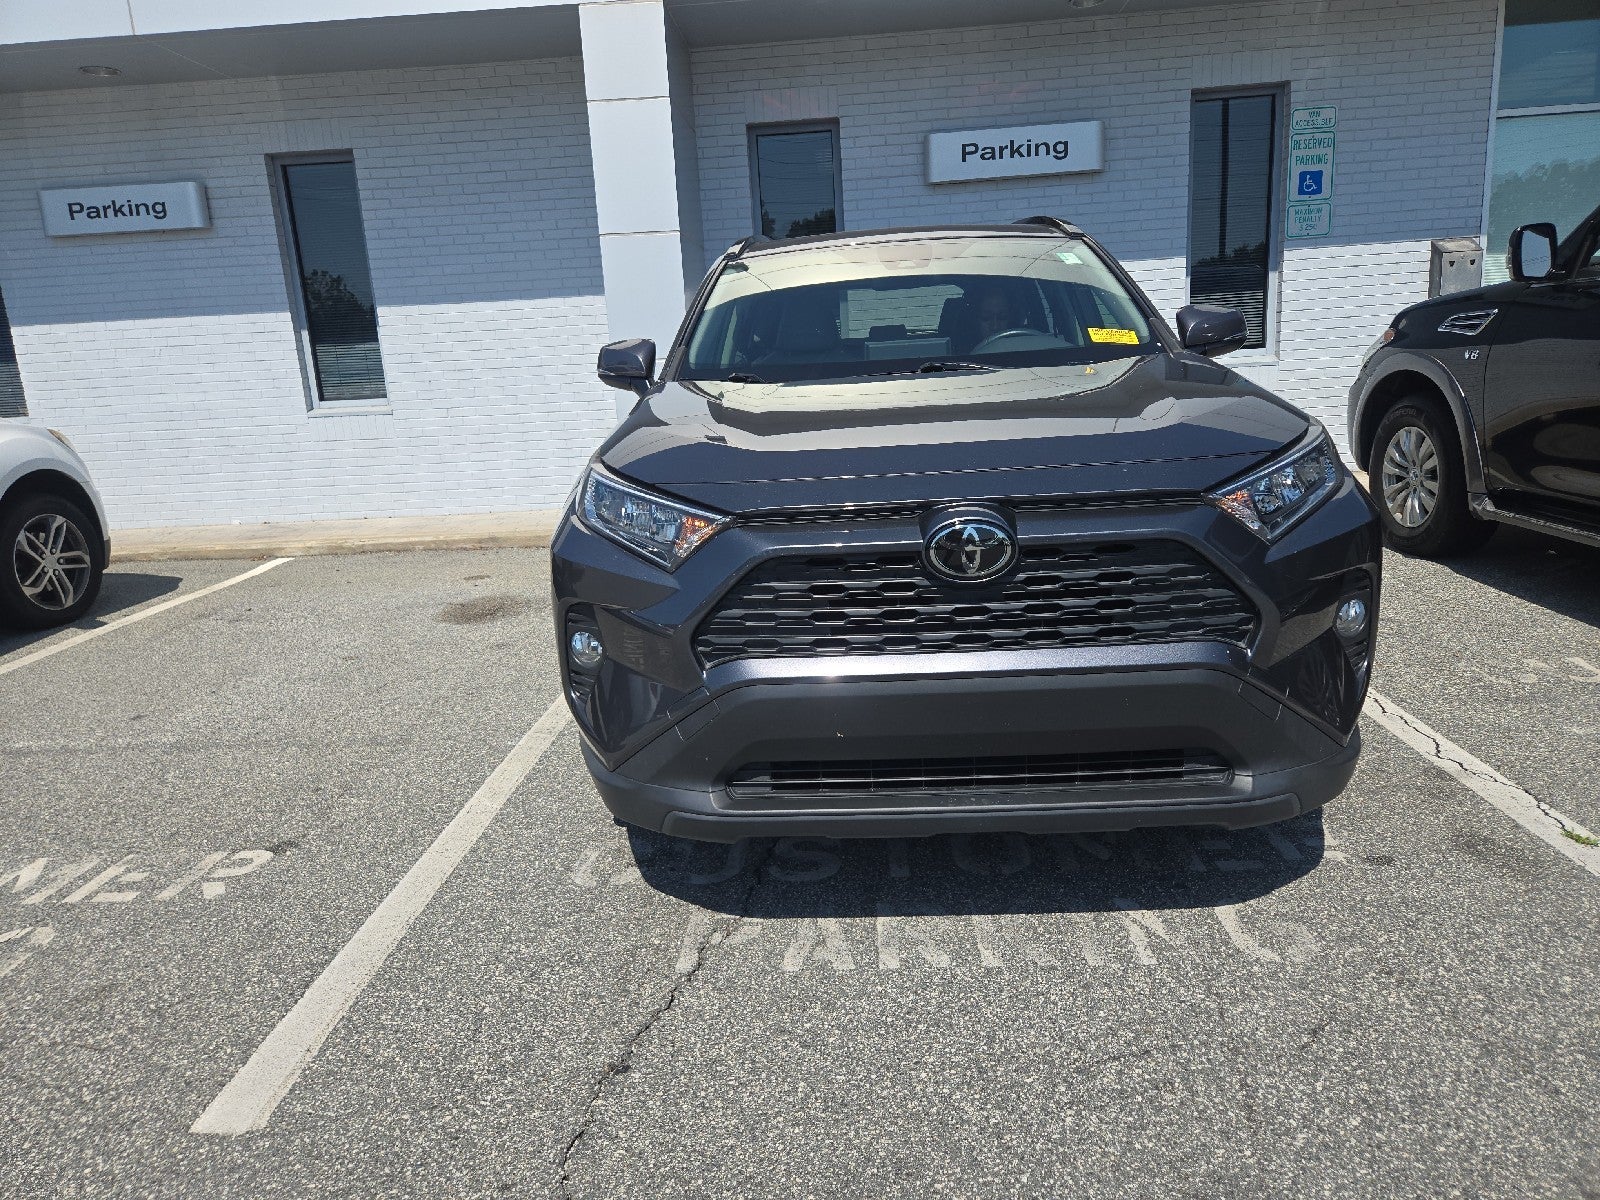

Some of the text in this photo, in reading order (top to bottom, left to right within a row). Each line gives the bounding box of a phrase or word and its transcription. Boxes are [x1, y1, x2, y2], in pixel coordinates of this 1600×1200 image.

[1308, 111, 1321, 119] VAN
[1293, 137, 1332, 150] RESERVED
[961, 139, 1069, 162] Parking
[1295, 153, 1328, 166] PARKING
[67, 200, 167, 220] Parking
[1294, 215, 1322, 224] PENALTY
